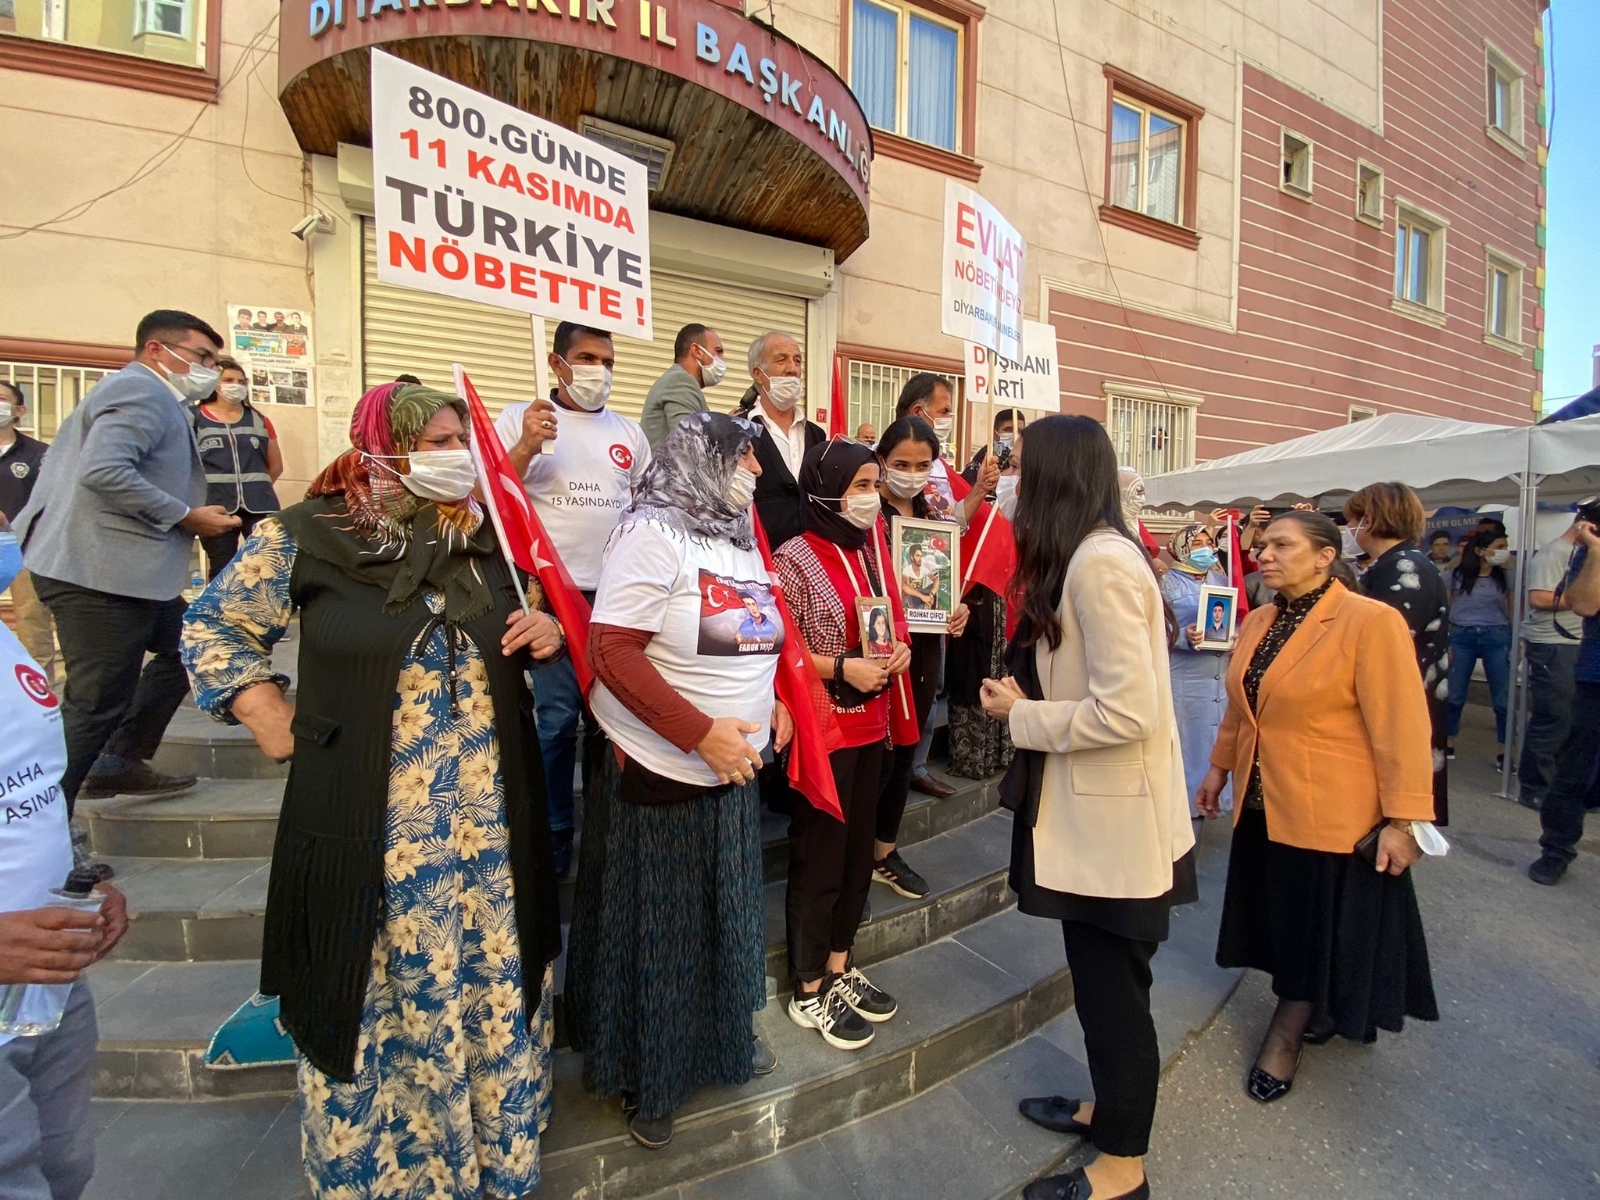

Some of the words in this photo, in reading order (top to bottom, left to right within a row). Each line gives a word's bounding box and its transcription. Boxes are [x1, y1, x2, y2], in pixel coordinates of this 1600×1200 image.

[408, 85, 626, 196] 800.GÜNDE
[696, 22, 872, 192] BAŞKANLIĞ
[399, 128, 447, 169] 11
[467, 149, 635, 234] KASIMDA
[385, 175, 643, 289] TÜRKİYE
[956, 201, 1023, 283] EVLAT
[388, 231, 622, 320] NÖBETTE
[551, 496, 562, 506] 15
[568, 481, 602, 492] DAHA
[1427, 519, 1449, 529] TLER
[909, 610, 929, 618] ROJHAT
[930, 611, 944, 620] ÇİFÇİ
